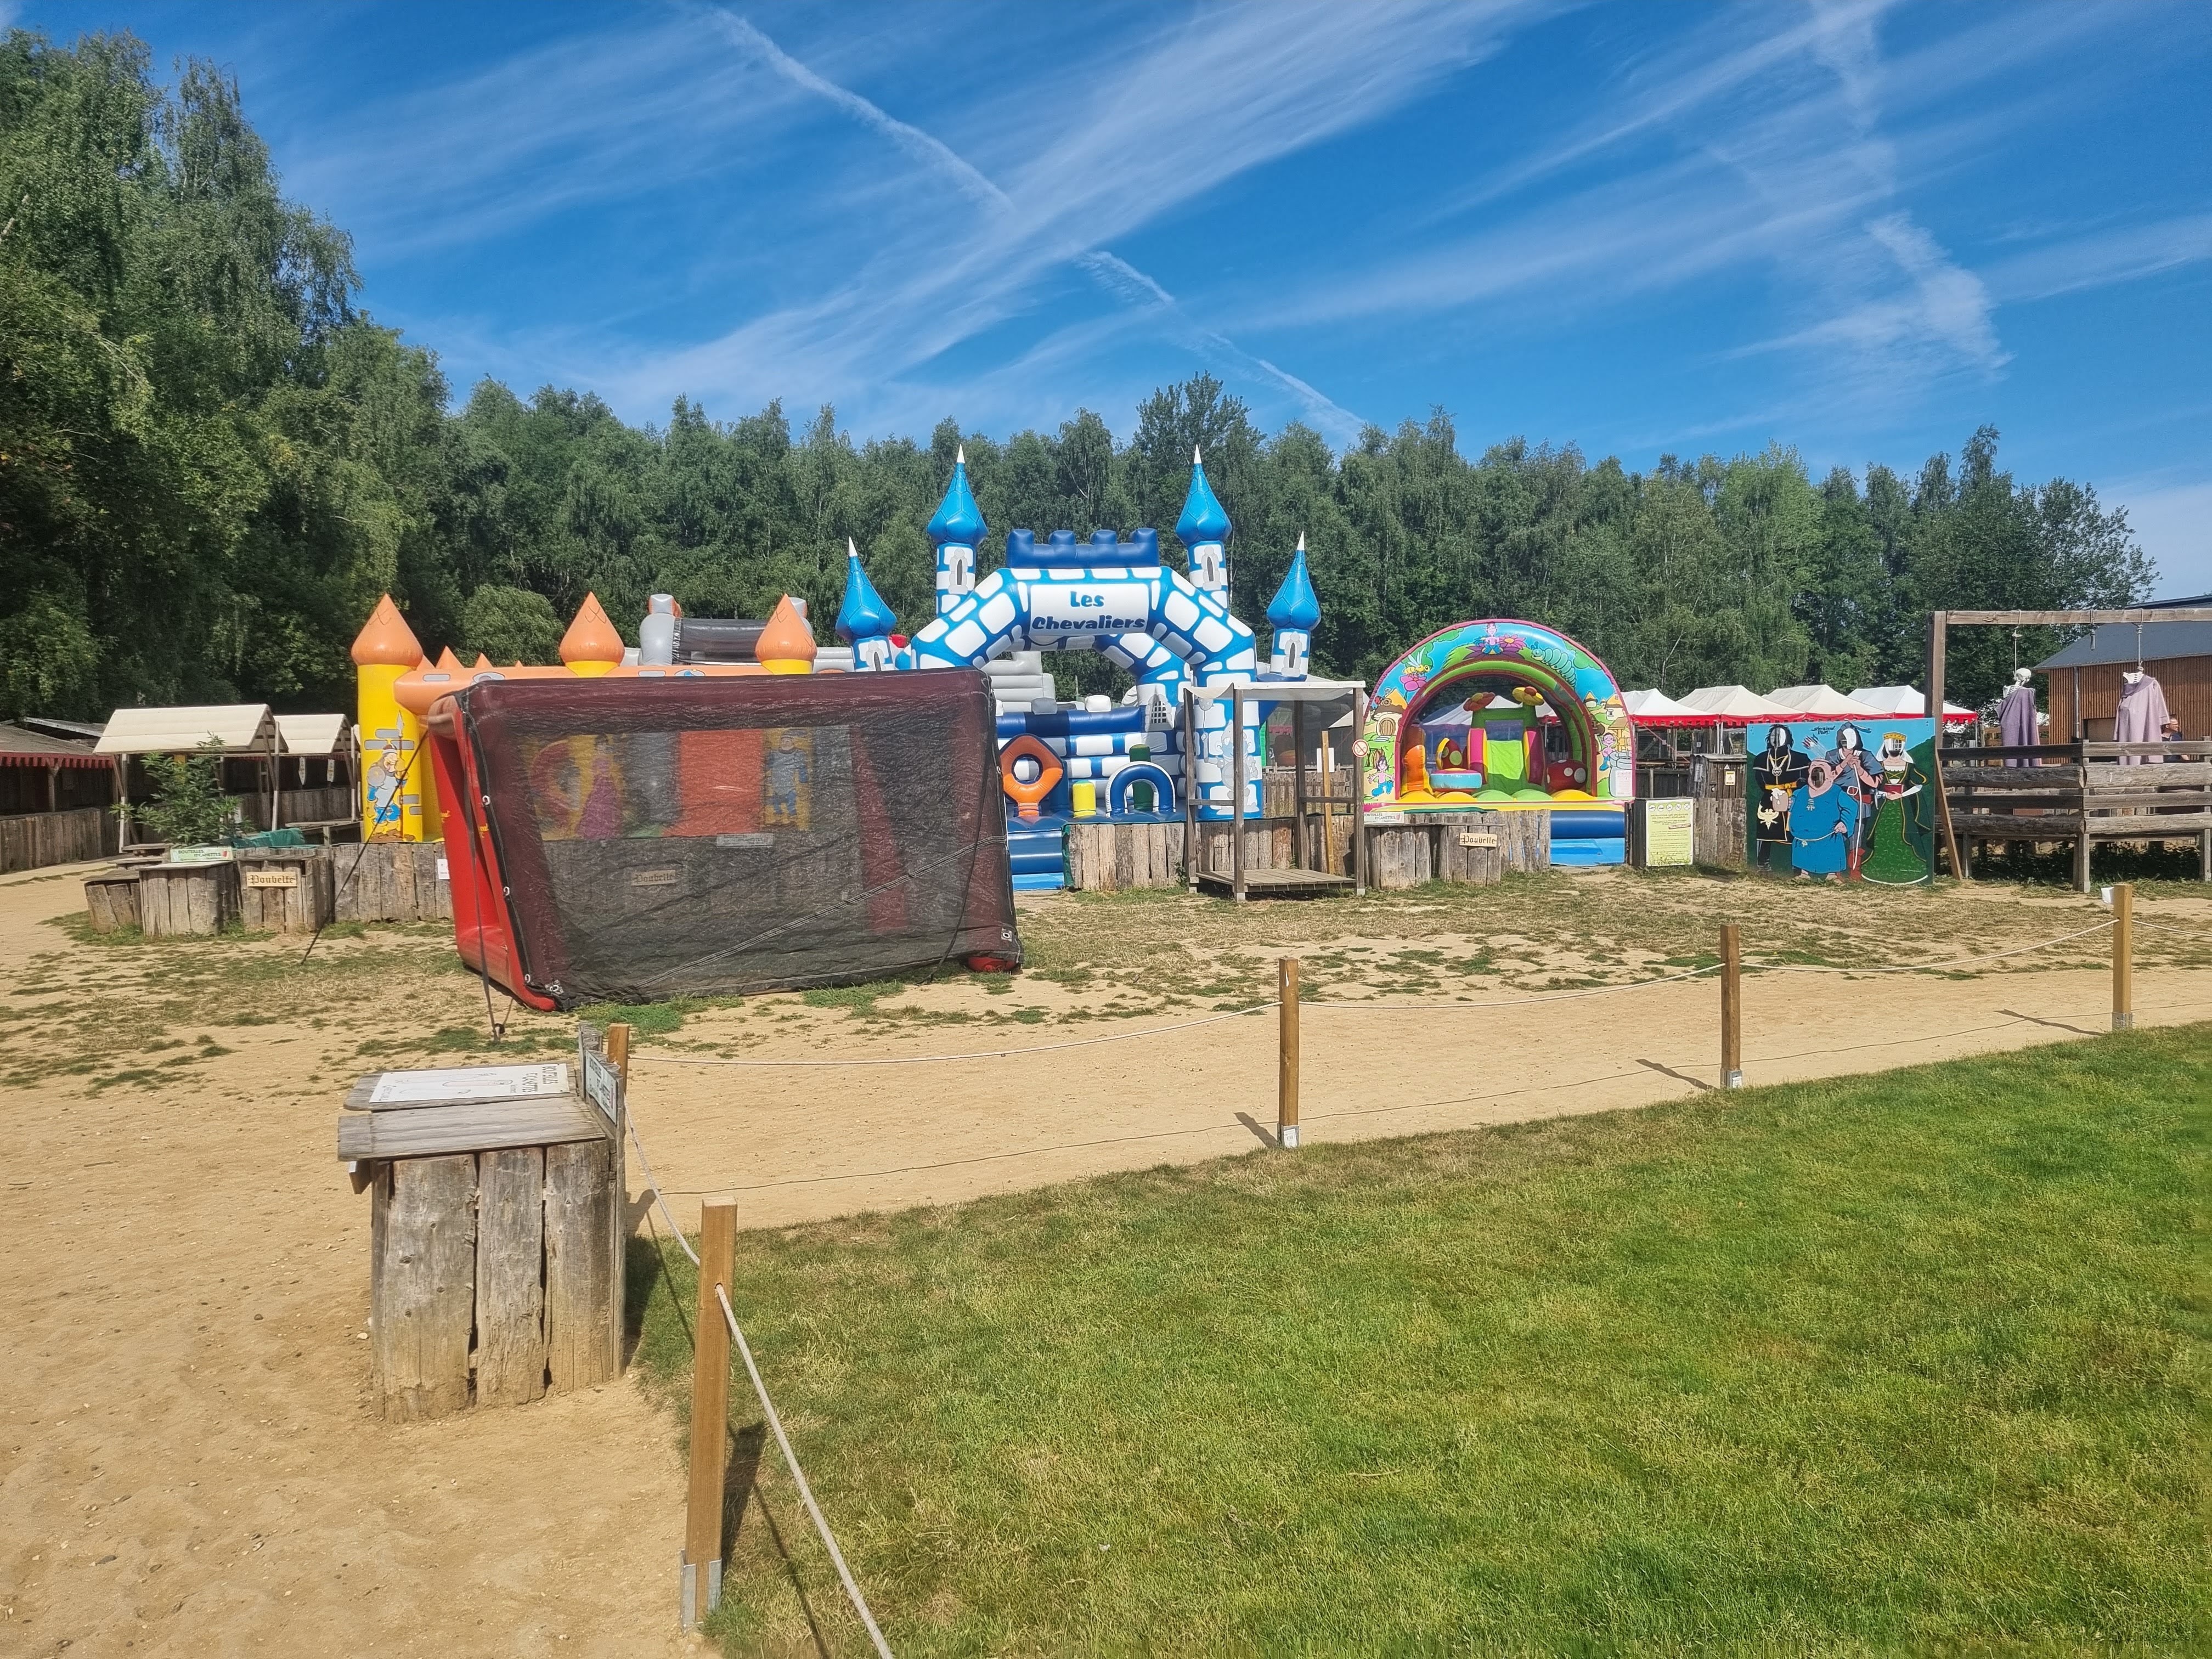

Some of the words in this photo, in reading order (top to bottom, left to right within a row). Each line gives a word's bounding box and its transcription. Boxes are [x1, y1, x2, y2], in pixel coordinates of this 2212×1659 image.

[1070, 591, 1104, 607] Les
[1032, 615, 1145, 629] Chevaliers
[1460, 835, 1497, 844] Poubelle
[248, 874, 296, 885] Poubelle
